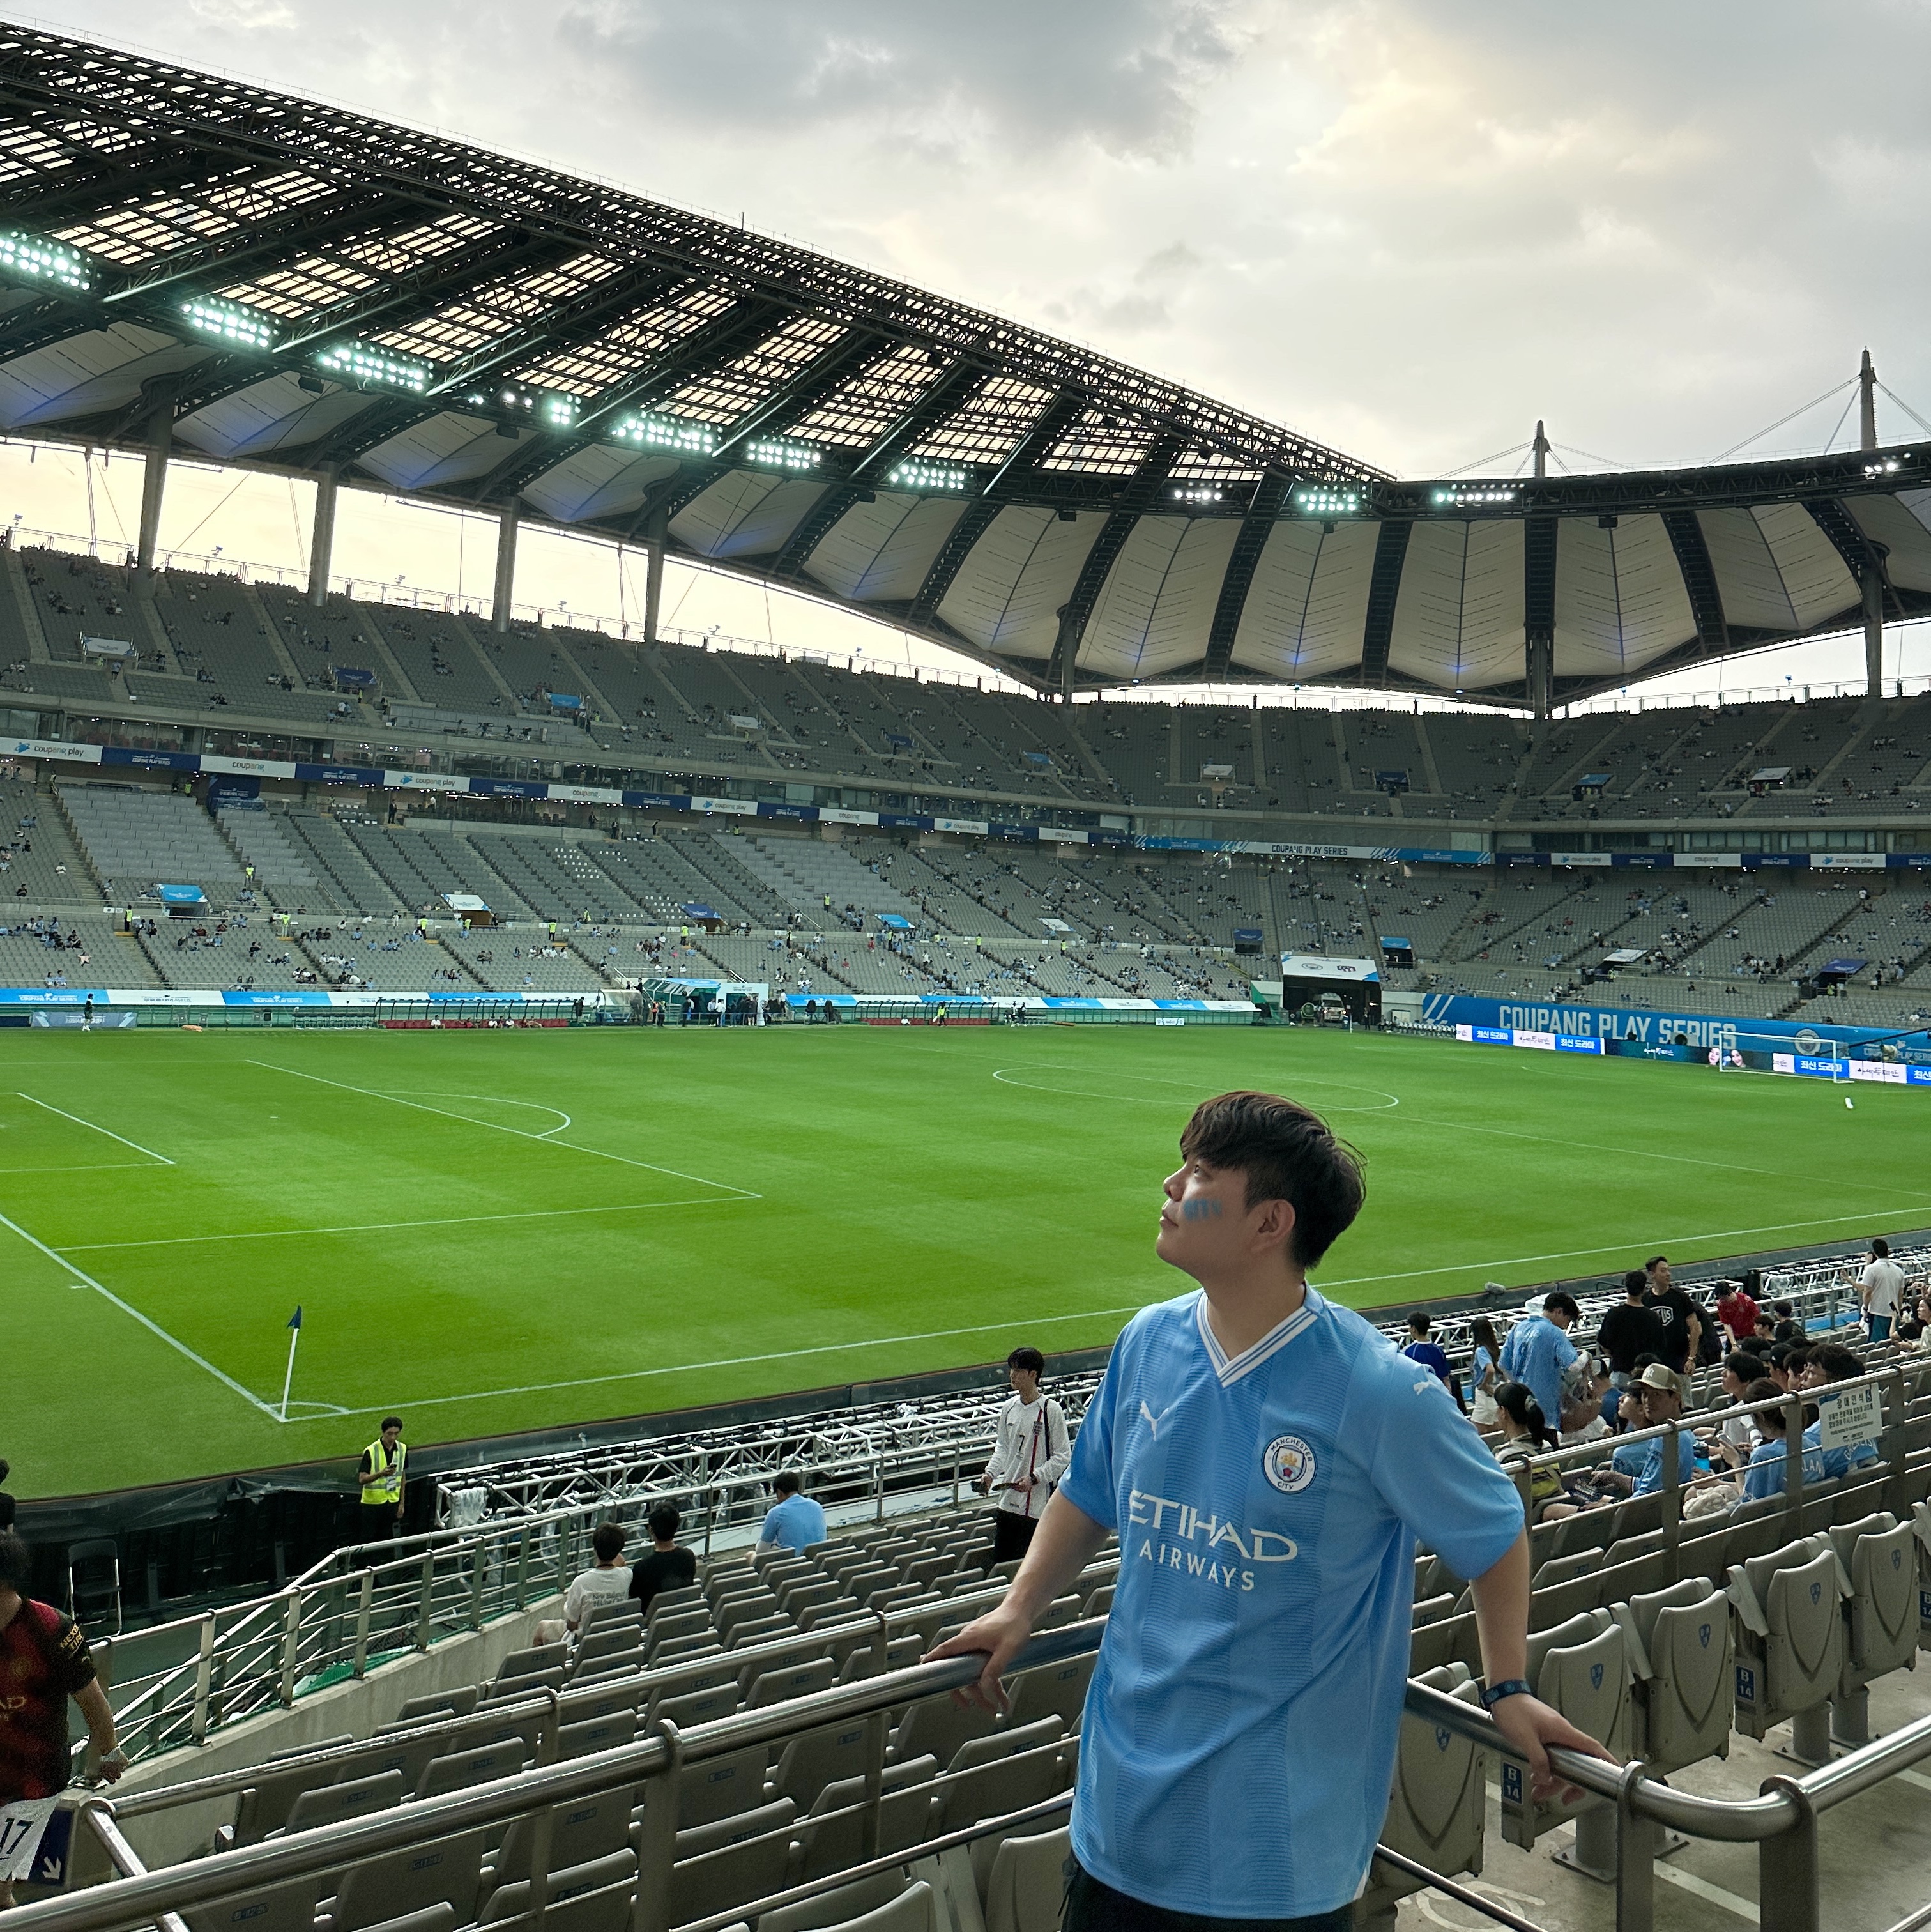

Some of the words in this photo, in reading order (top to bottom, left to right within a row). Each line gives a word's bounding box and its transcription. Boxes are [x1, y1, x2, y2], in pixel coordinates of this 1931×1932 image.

[34, 746, 66, 755] coupang
[68, 747, 84, 757] play
[232, 762, 265, 771] coupang
[415, 778, 441, 786] coupang
[443, 779, 455, 788] play
[572, 789, 599, 797] coupang
[1271, 845, 1303, 854] COUPANG
[1304, 846, 1322, 854] PLAY
[1324, 847, 1348, 855] SERIES
[1499, 1005, 1591, 1036] COUPANG
[1599, 1013, 1651, 1042] PLAY
[1658, 1018, 1737, 1050] SERIES
[1477, 1030, 1489, 1039] 최신
[1490, 1031, 1509, 1041] 드라마
[1561, 1038, 1574, 1047] 최신
[1575, 1039, 1595, 1050] 드라마
[1800, 1060, 1817, 1070] 최신
[1818, 1061, 1843, 1073] 드라마
[1914, 1070, 1931, 1081] 최신
[1019, 1435, 1025, 1452] 7
[1271, 1438, 1313, 1462] MANCHESTER
[1277, 1481, 1294, 1490] CITY
[1129, 1489, 1298, 1562] ETIHAD
[1139, 1539, 1255, 1591] AIRWAYS
[1923, 1593, 1931, 1604] B
[60, 1622, 79, 1648] NEXE
[1741, 1669, 1749, 1682] B
[1739, 1685, 1752, 1698] 14
[1507, 1766, 1517, 1782] B
[1506, 1785, 1520, 1800] 14
